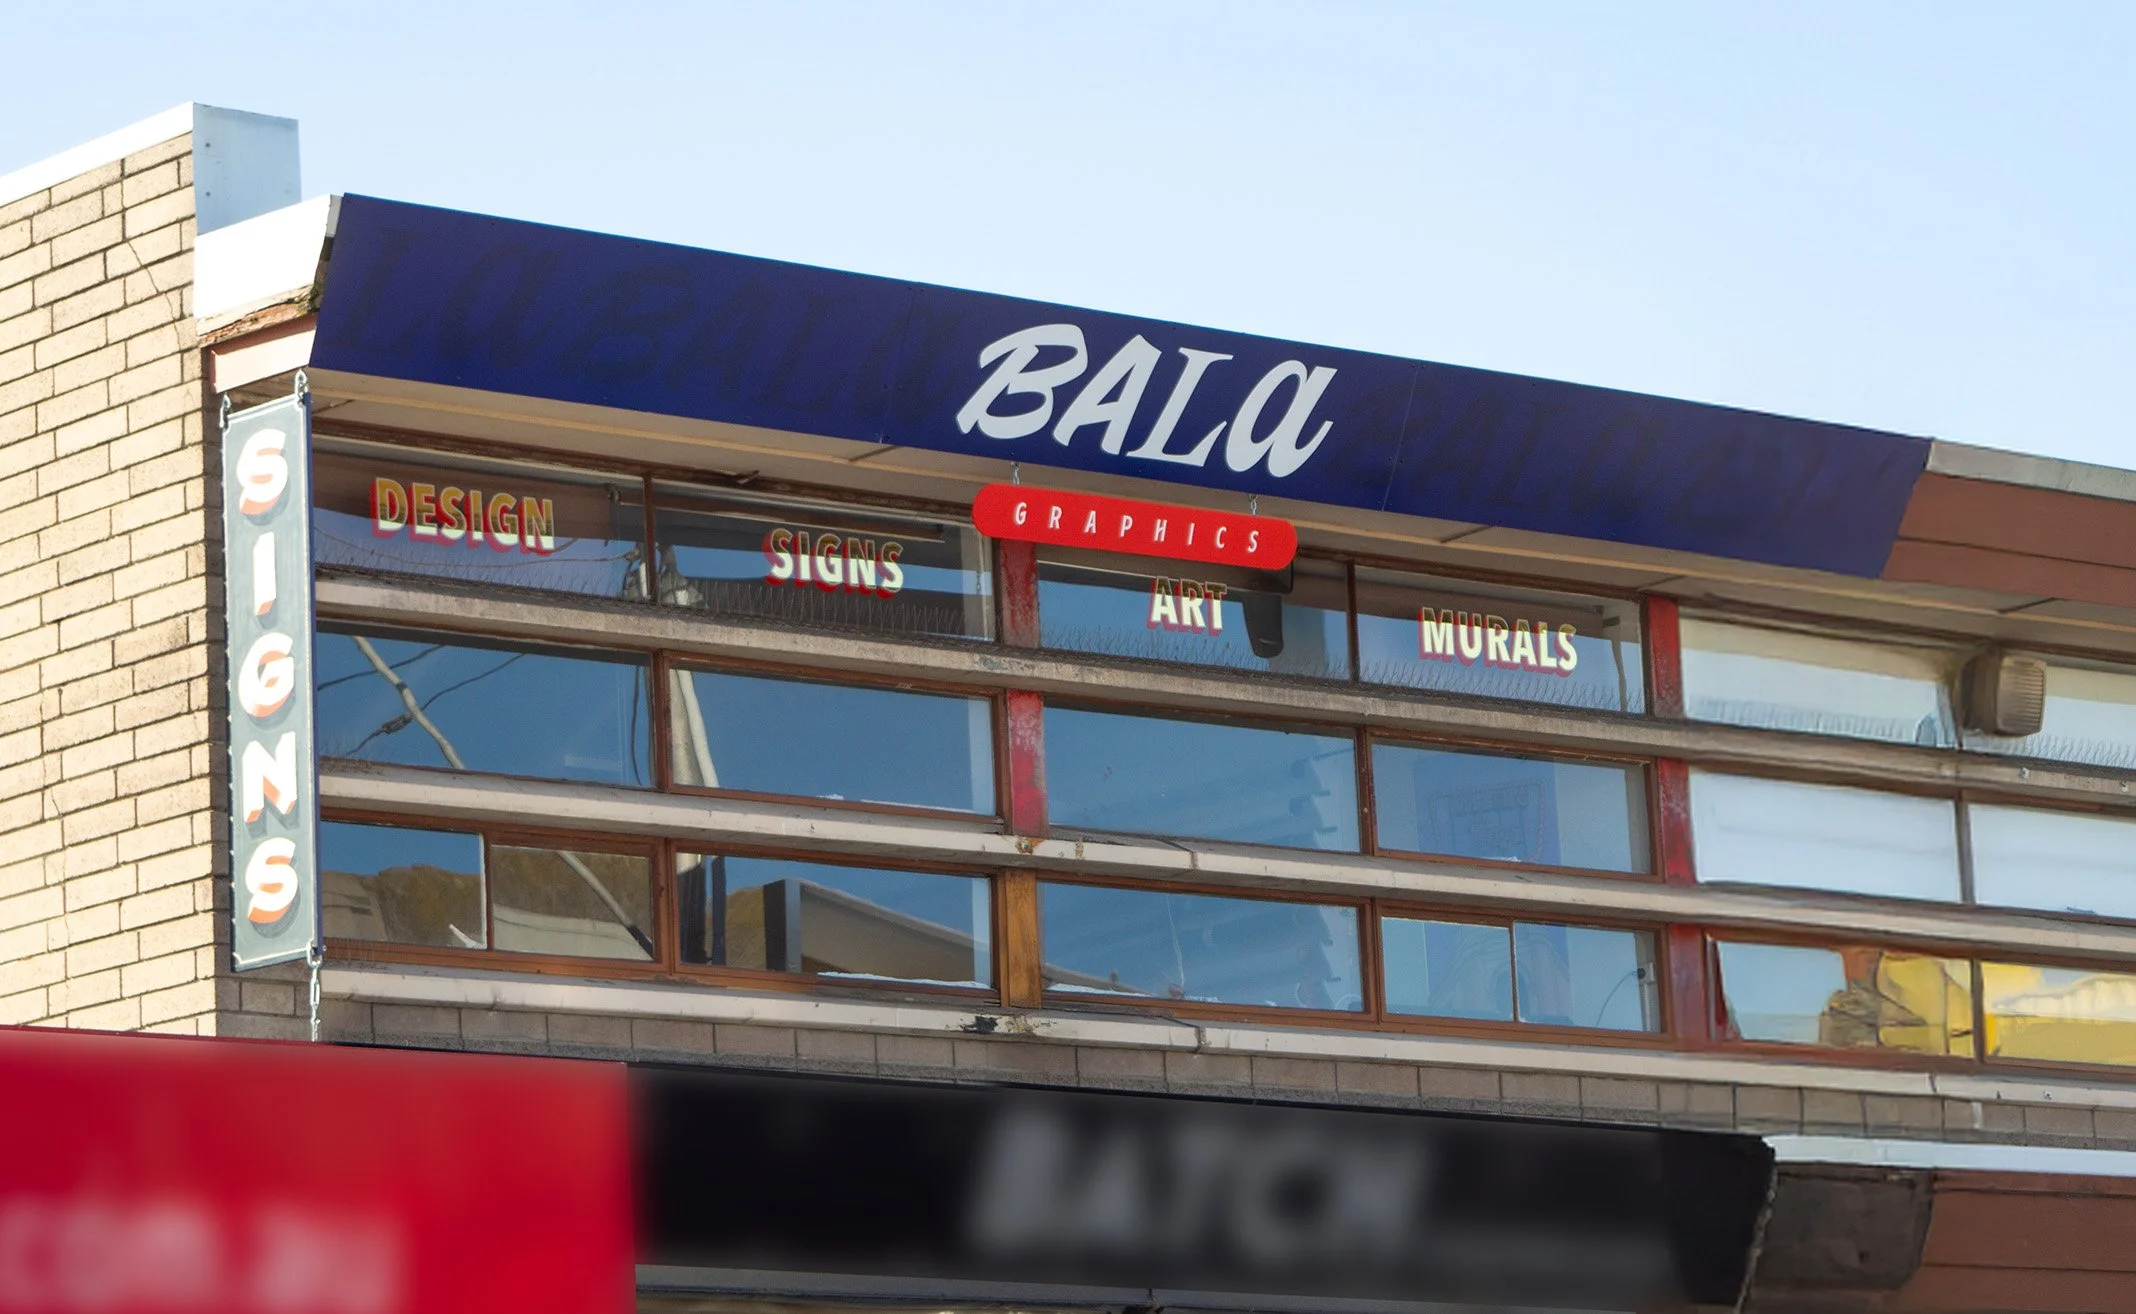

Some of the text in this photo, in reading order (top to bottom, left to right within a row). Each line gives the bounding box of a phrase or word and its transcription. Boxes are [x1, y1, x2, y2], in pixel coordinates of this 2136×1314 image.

[370, 477, 556, 556] DESIGN
[1013, 501, 1260, 553] GRAPHICS
[763, 528, 904, 598] SIGNS
[1147, 575, 1228, 636] ART
[1418, 606, 1578, 676] MURALS
[235, 428, 299, 927] SIGNS
